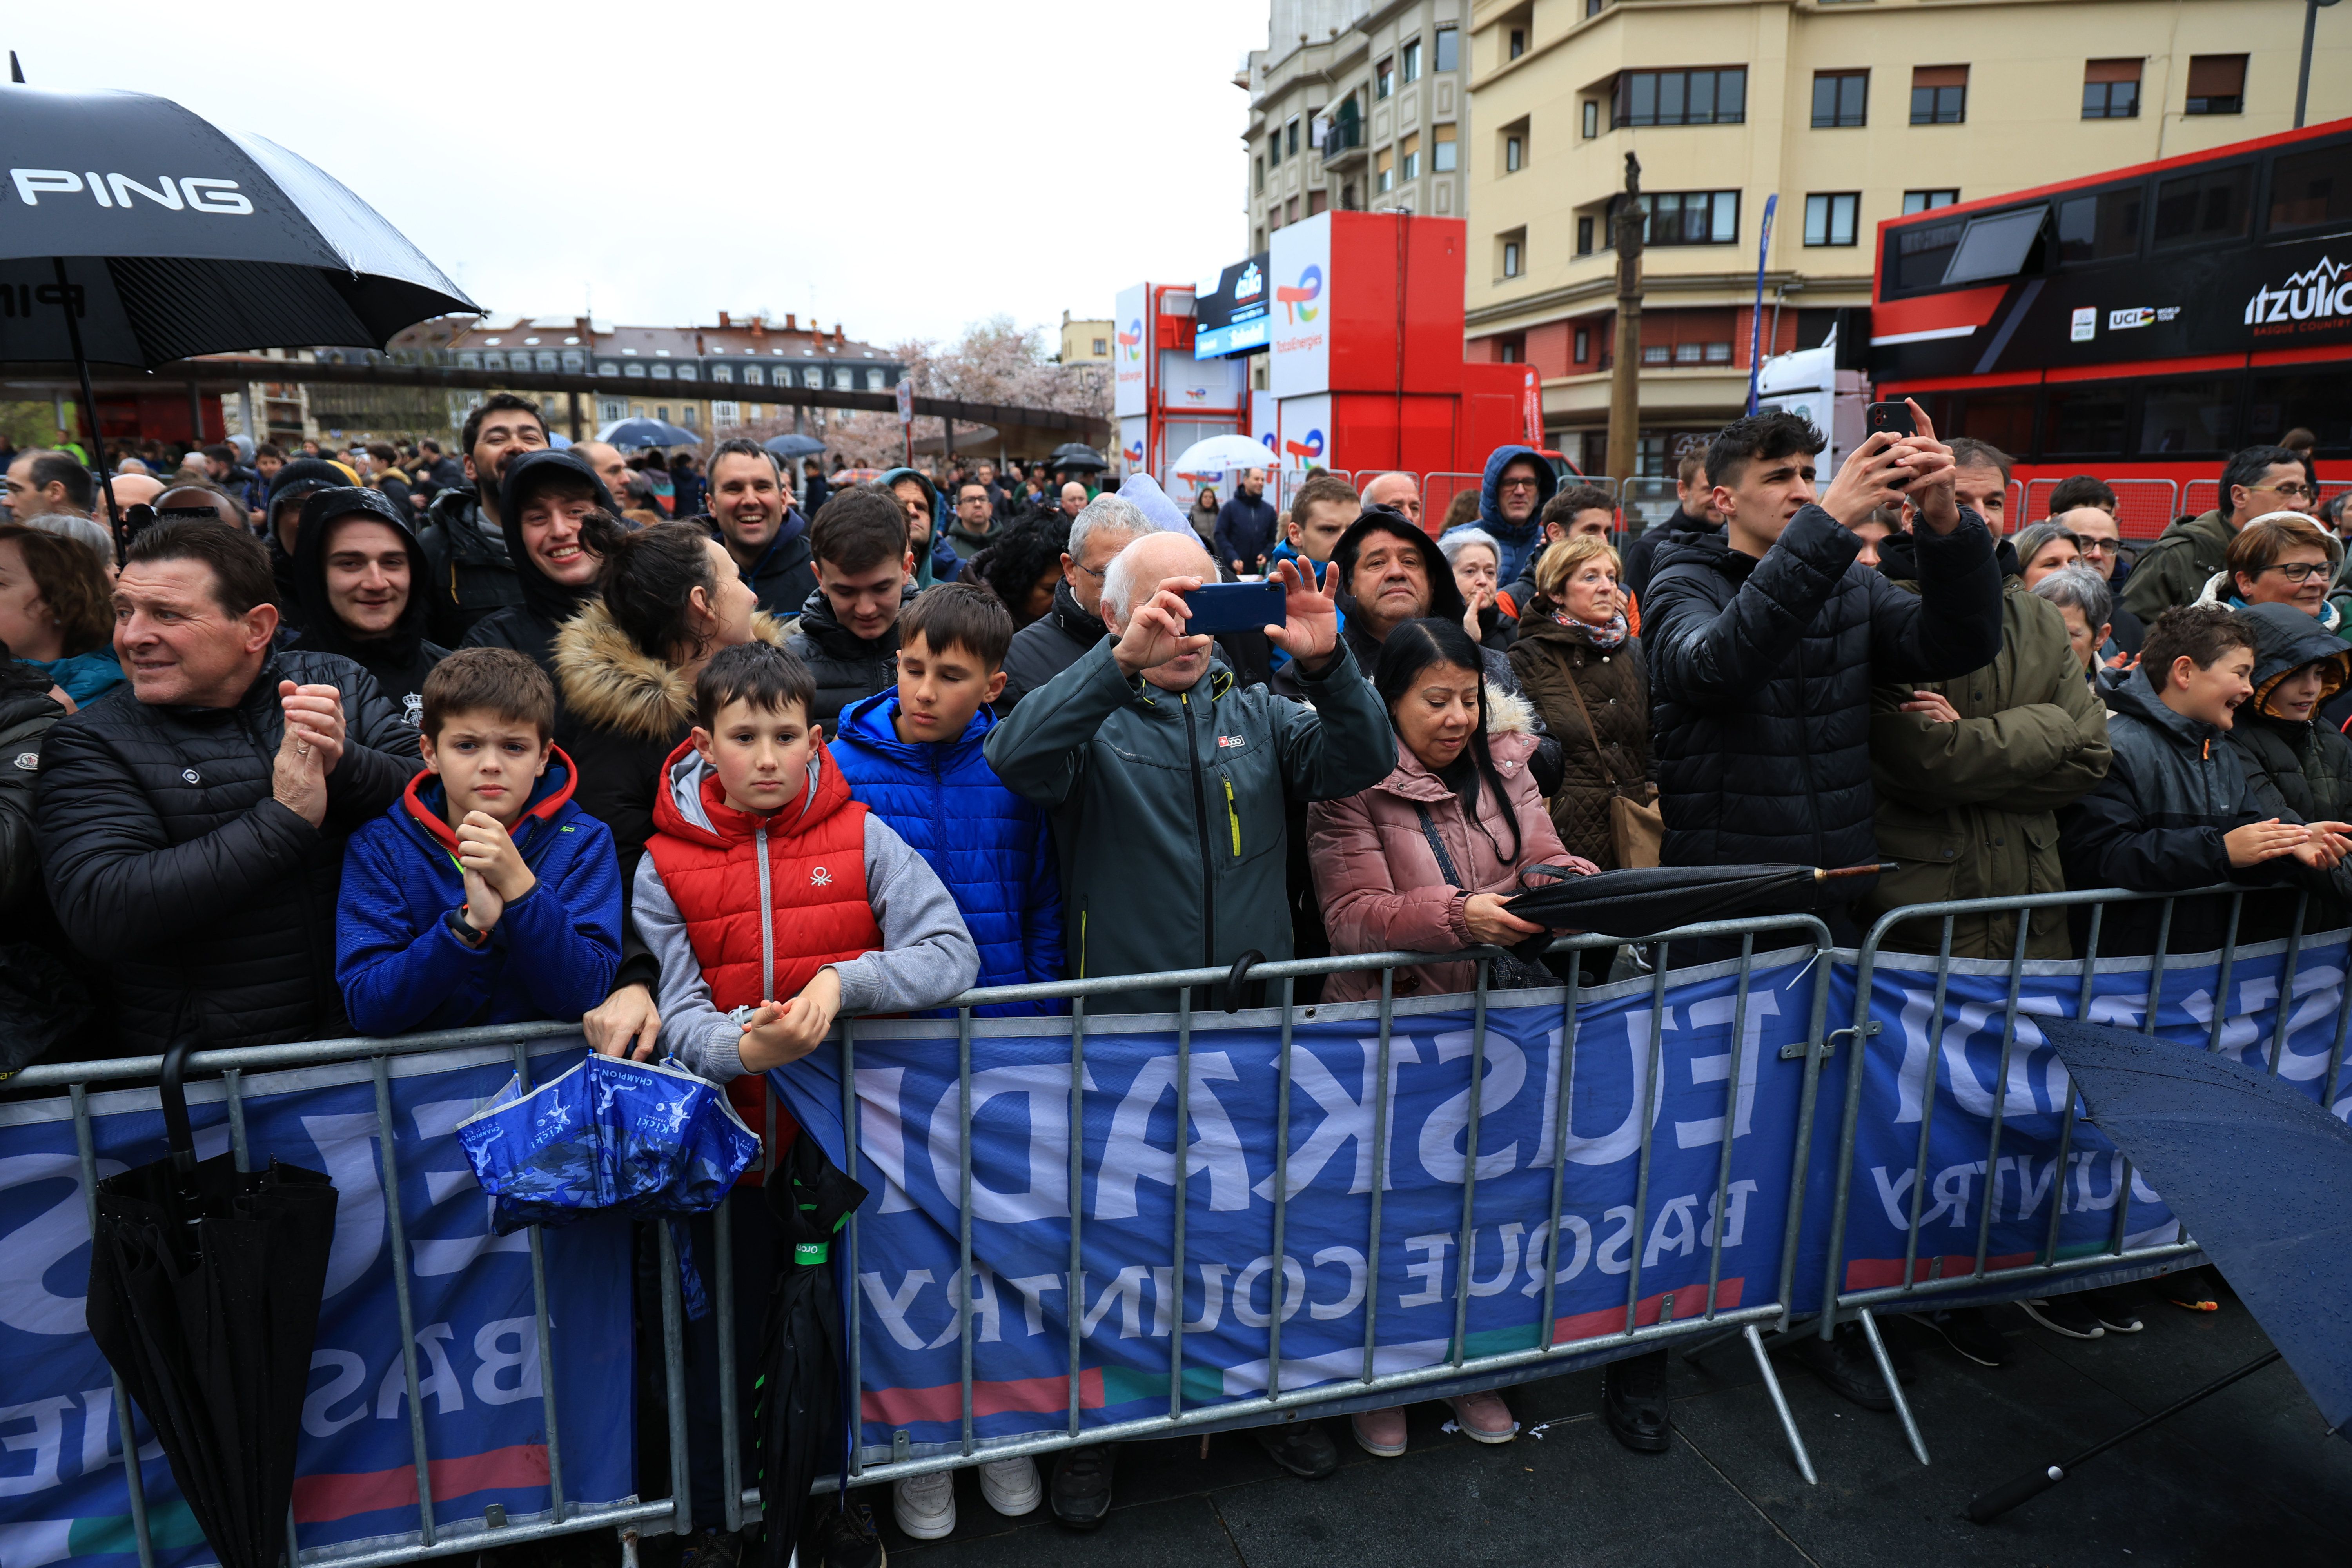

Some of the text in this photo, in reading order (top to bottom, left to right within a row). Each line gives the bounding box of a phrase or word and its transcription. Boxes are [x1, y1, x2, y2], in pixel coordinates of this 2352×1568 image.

[9, 168, 254, 214] PING
[2113, 314, 2136, 325] UCI
[2254, 318, 2351, 337] BASQUE COUNTRY
[602, 1069, 652, 1086] CHAMPION
[646, 1114, 666, 1123] FOOTBALL
[465, 1121, 498, 1137] SOCCER
[534, 1124, 555, 1138] FOOTBALL
